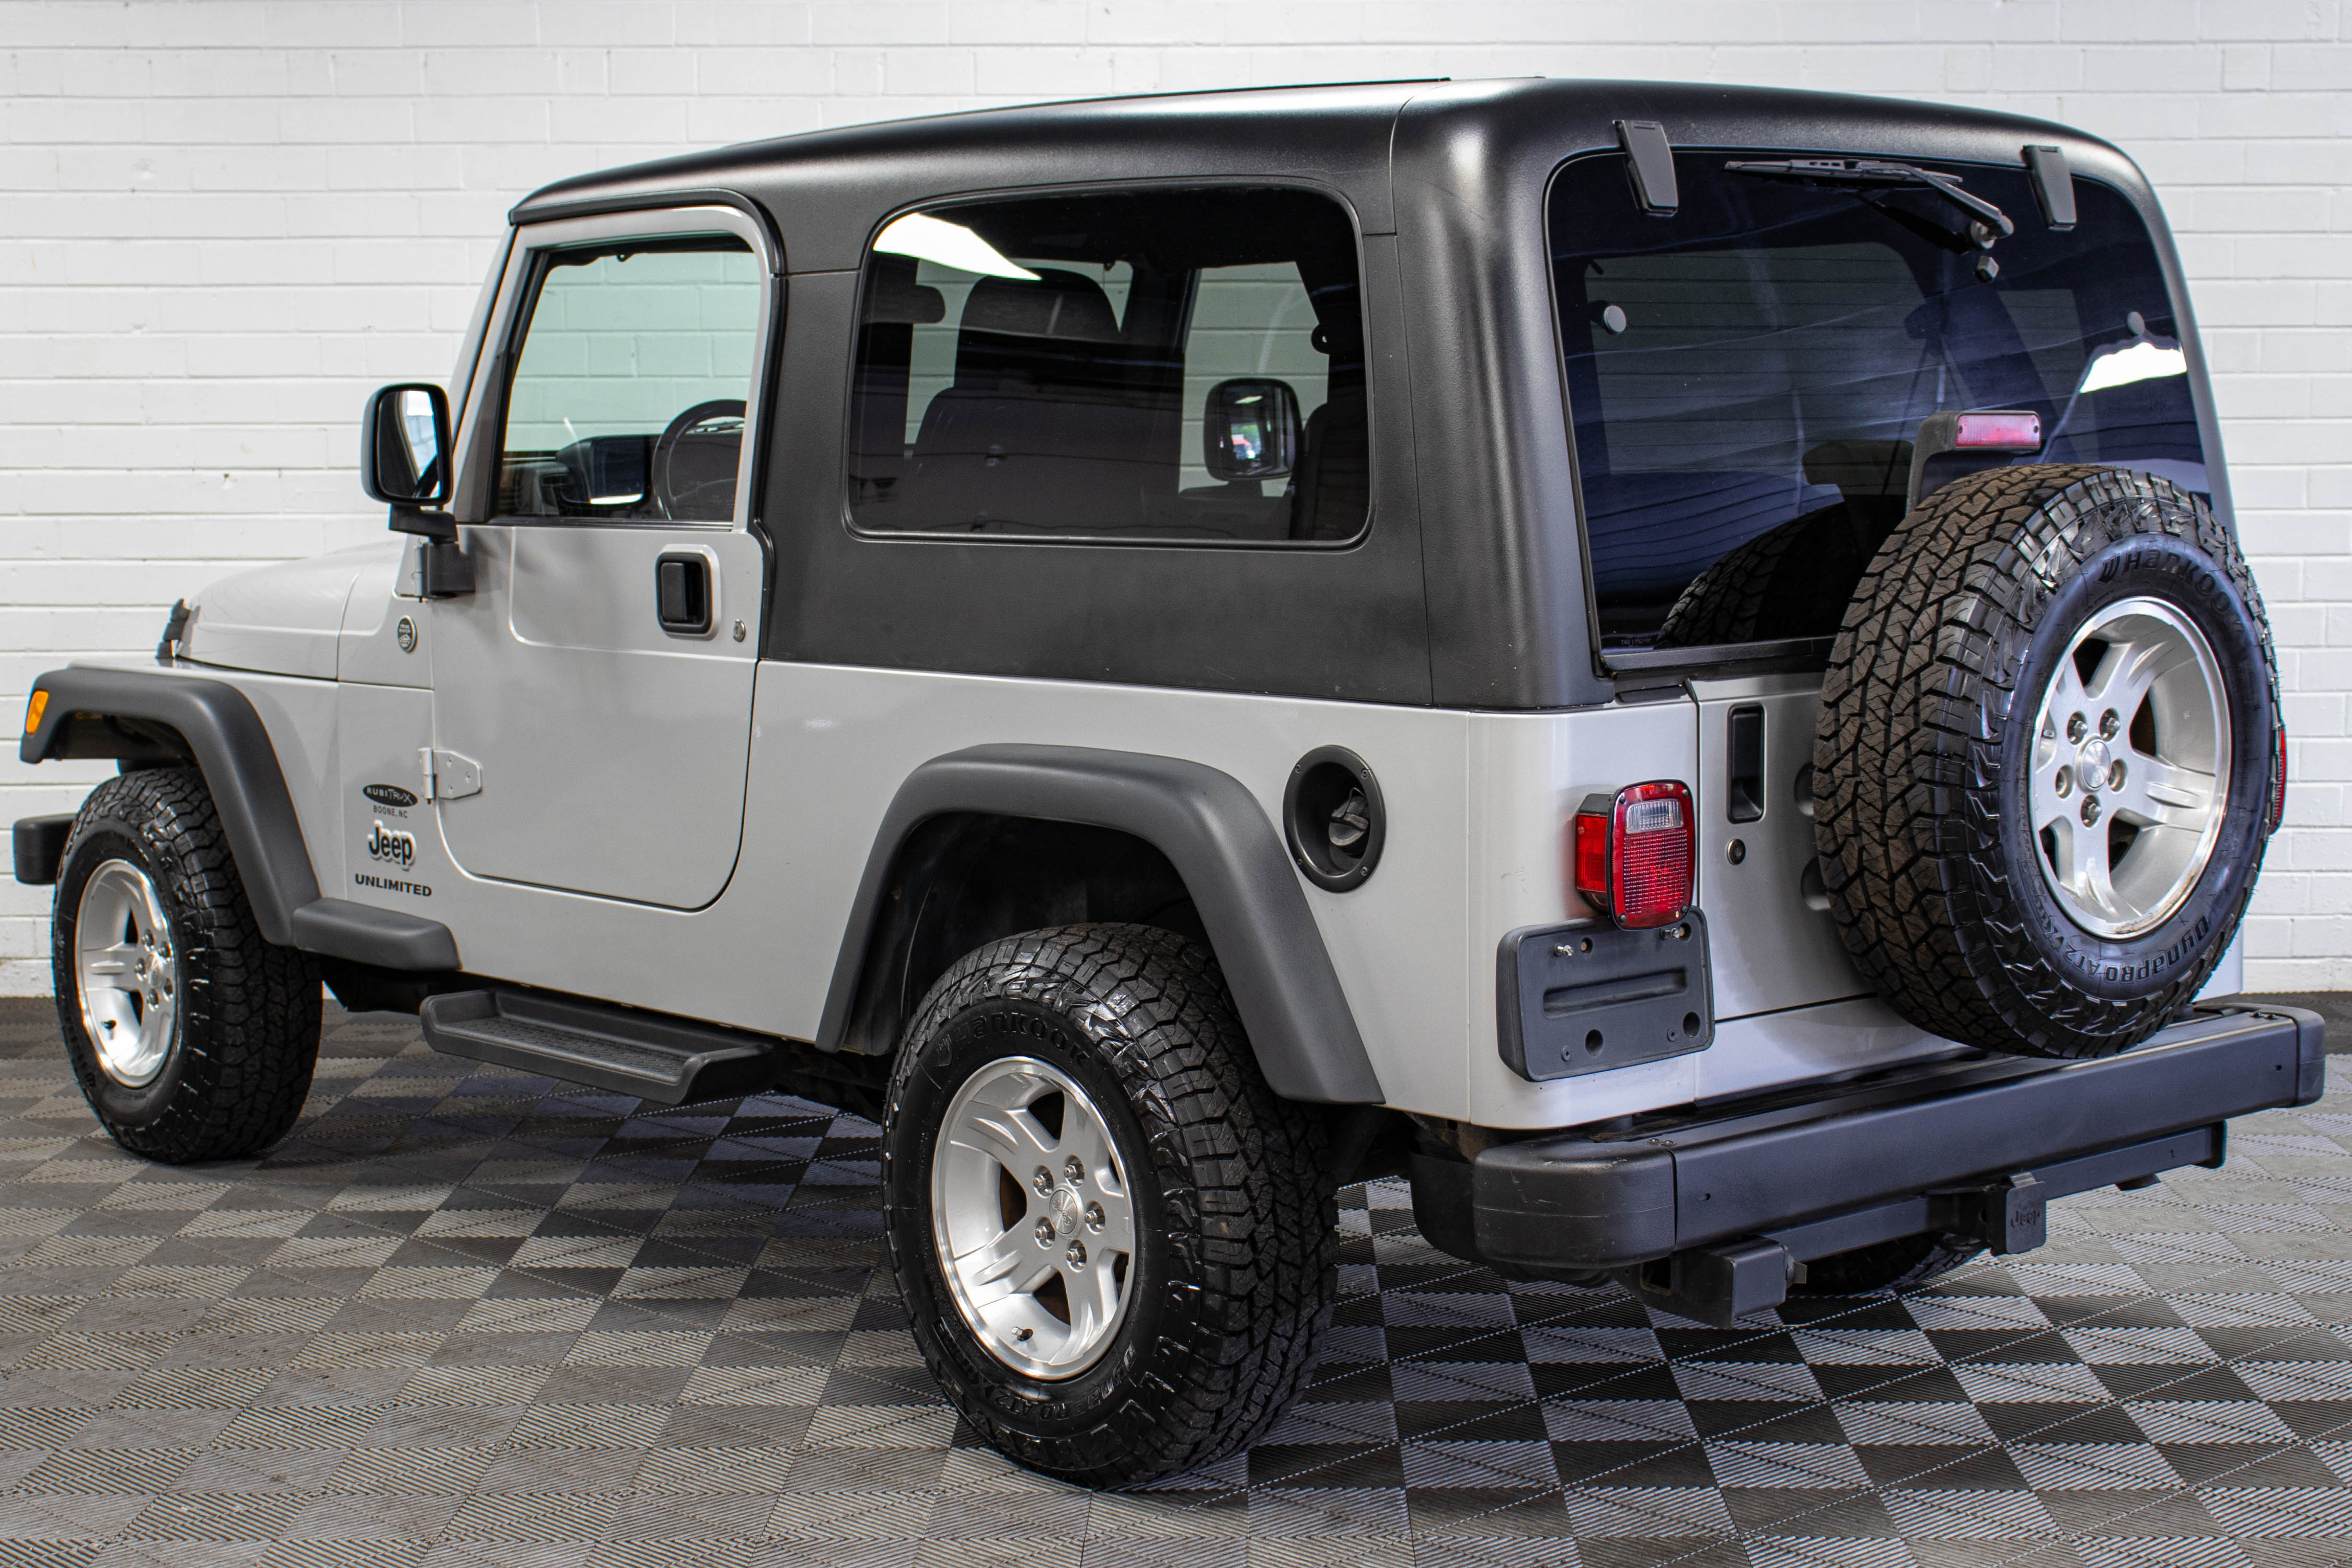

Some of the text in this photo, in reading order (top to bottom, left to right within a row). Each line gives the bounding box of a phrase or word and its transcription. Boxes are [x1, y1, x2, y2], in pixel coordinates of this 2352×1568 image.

[398, 810, 408, 818] NC
[367, 821, 415, 867] Jeep
[354, 873, 432, 897] UNLIMITED
[2062, 942, 2101, 979] AT2
[2010, 1209, 2040, 1228] Jeep
